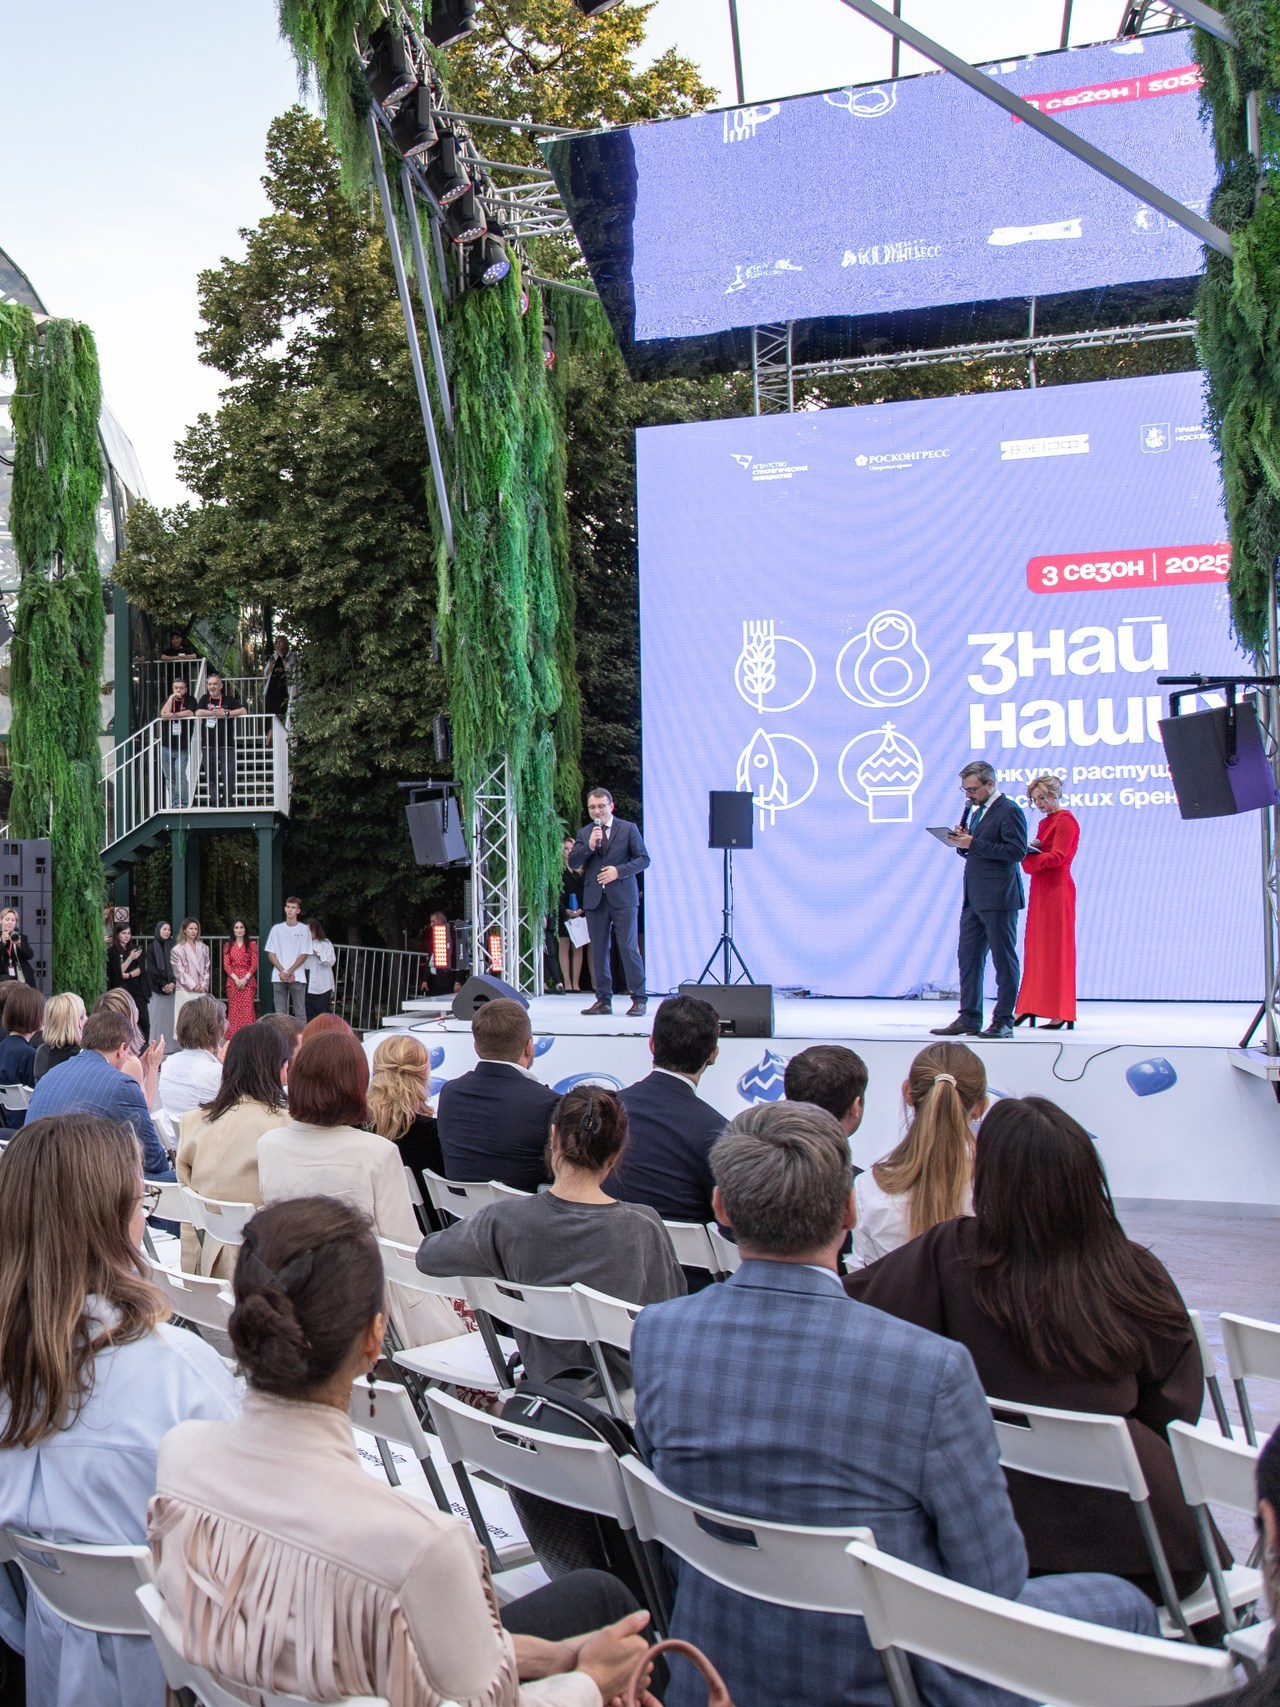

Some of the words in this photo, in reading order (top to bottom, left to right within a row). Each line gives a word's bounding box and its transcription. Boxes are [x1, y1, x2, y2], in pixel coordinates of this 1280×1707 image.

[869, 448, 951, 464] РОСКОНГРЕСС
[1042, 566, 1058, 586] 3
[1064, 560, 1144, 583] сезон
[1165, 554, 1229, 575] 2025
[1072, 764, 1172, 784] растущ
[1120, 787, 1179, 810] брен
